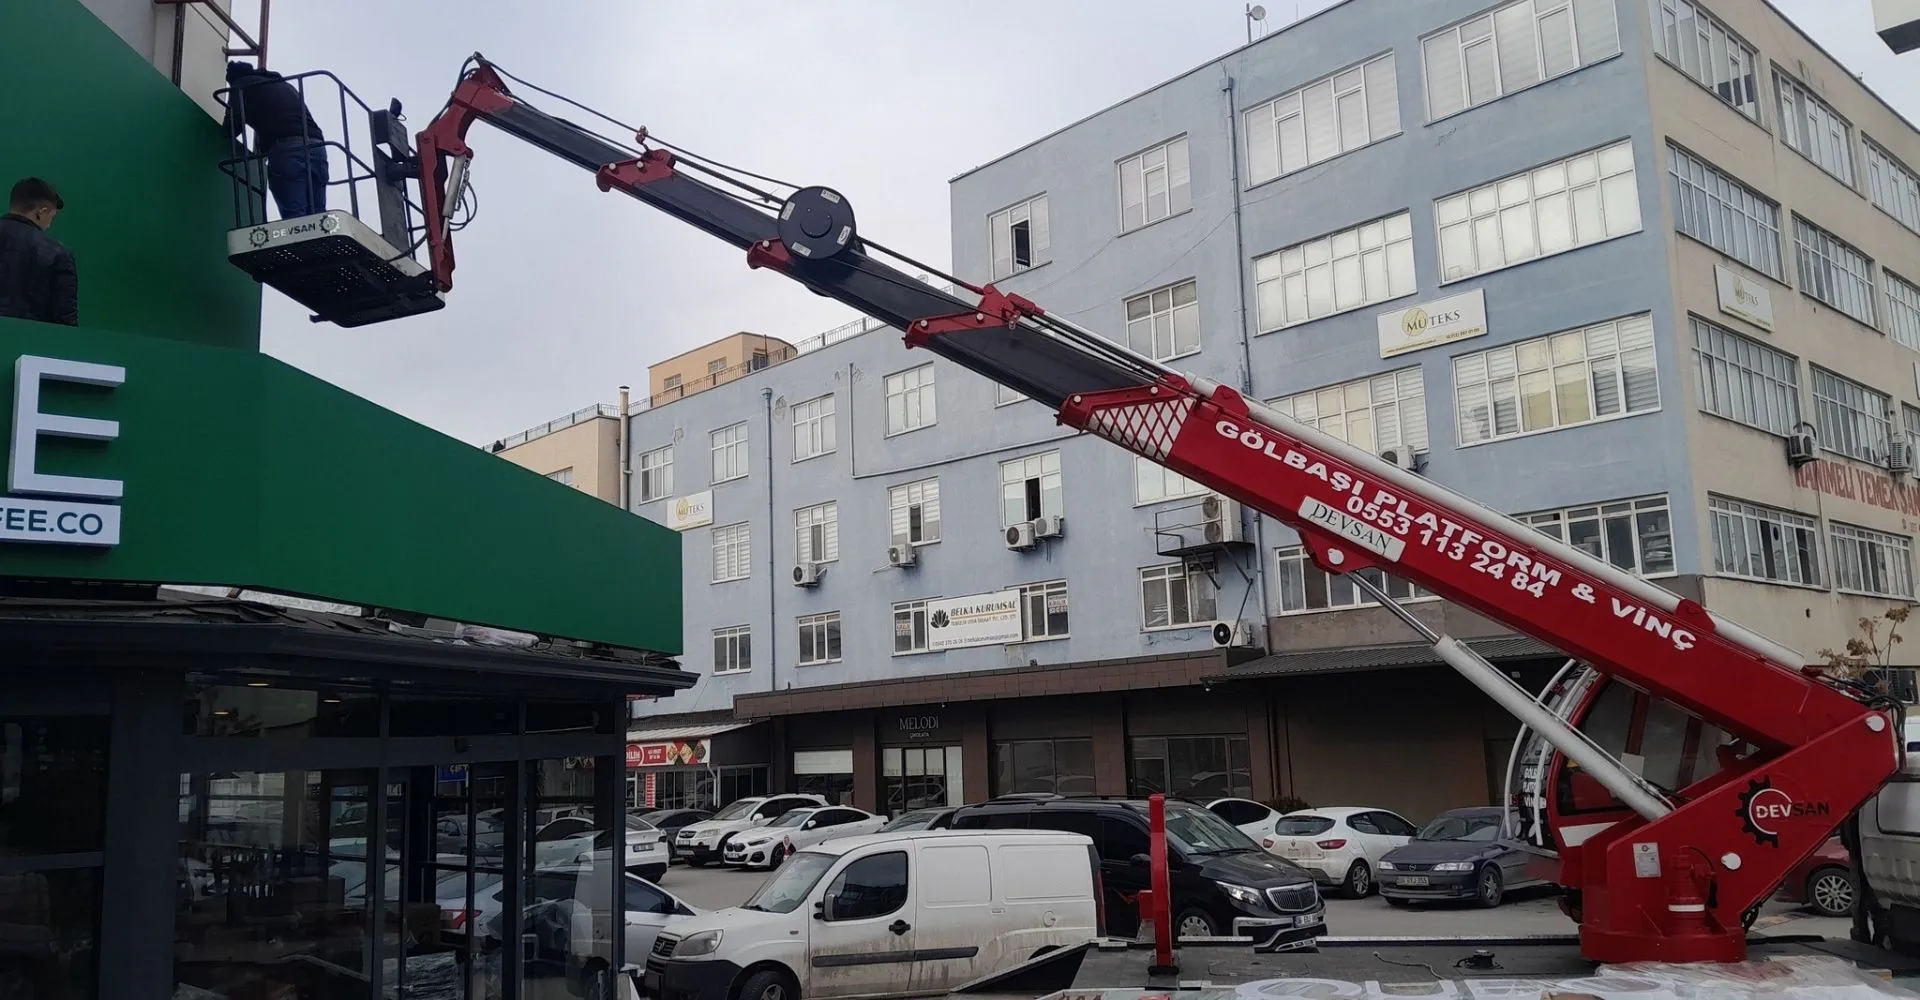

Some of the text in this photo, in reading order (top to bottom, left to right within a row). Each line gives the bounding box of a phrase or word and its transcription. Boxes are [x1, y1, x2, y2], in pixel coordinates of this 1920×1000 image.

[272, 223, 316, 239] DEVSAN
[8, 354, 126, 497] E
[0, 507, 103, 536] EE.CO
[1216, 420, 1697, 650] GÖLBAŞI PLATFORM & VİNÇ
[1310, 503, 1393, 555] DEVSAN
[1346, 496, 1546, 598] 0553 113 24 84
[950, 601, 1017, 617] BELKA KURUMSAL
[1756, 801, 1829, 819] DEVSAN
